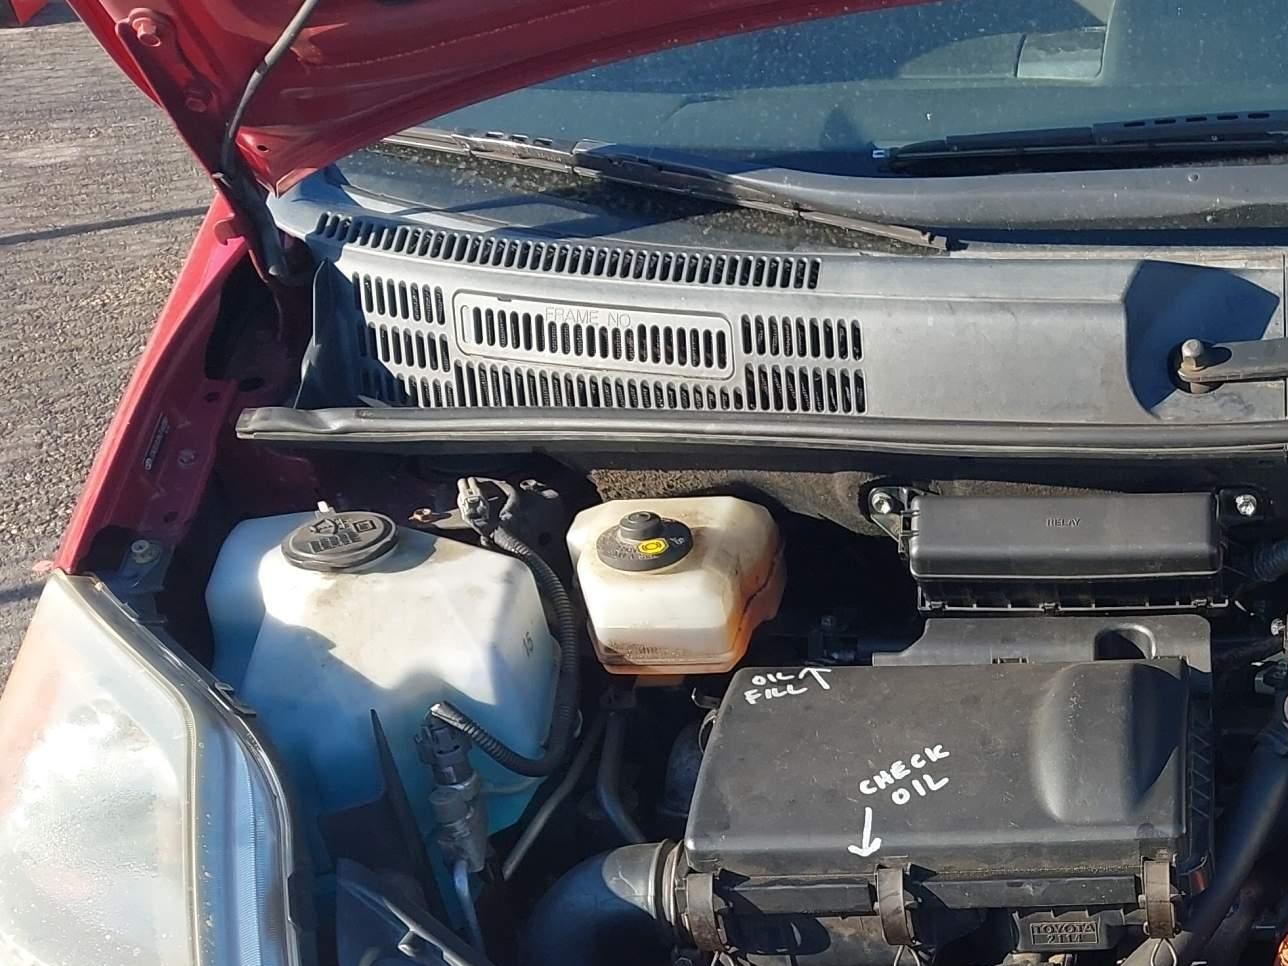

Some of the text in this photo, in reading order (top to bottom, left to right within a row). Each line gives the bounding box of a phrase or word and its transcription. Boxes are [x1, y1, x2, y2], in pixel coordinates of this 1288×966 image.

[545, 306, 599, 326] FRAME
[1046, 517, 1081, 528] RELAY
[751, 672, 795, 686] OIL
[743, 684, 808, 705] FILL
[859, 744, 950, 795] CHECK
[891, 774, 949, 805] OIL
[1031, 923, 1096, 934] TOYOTA
